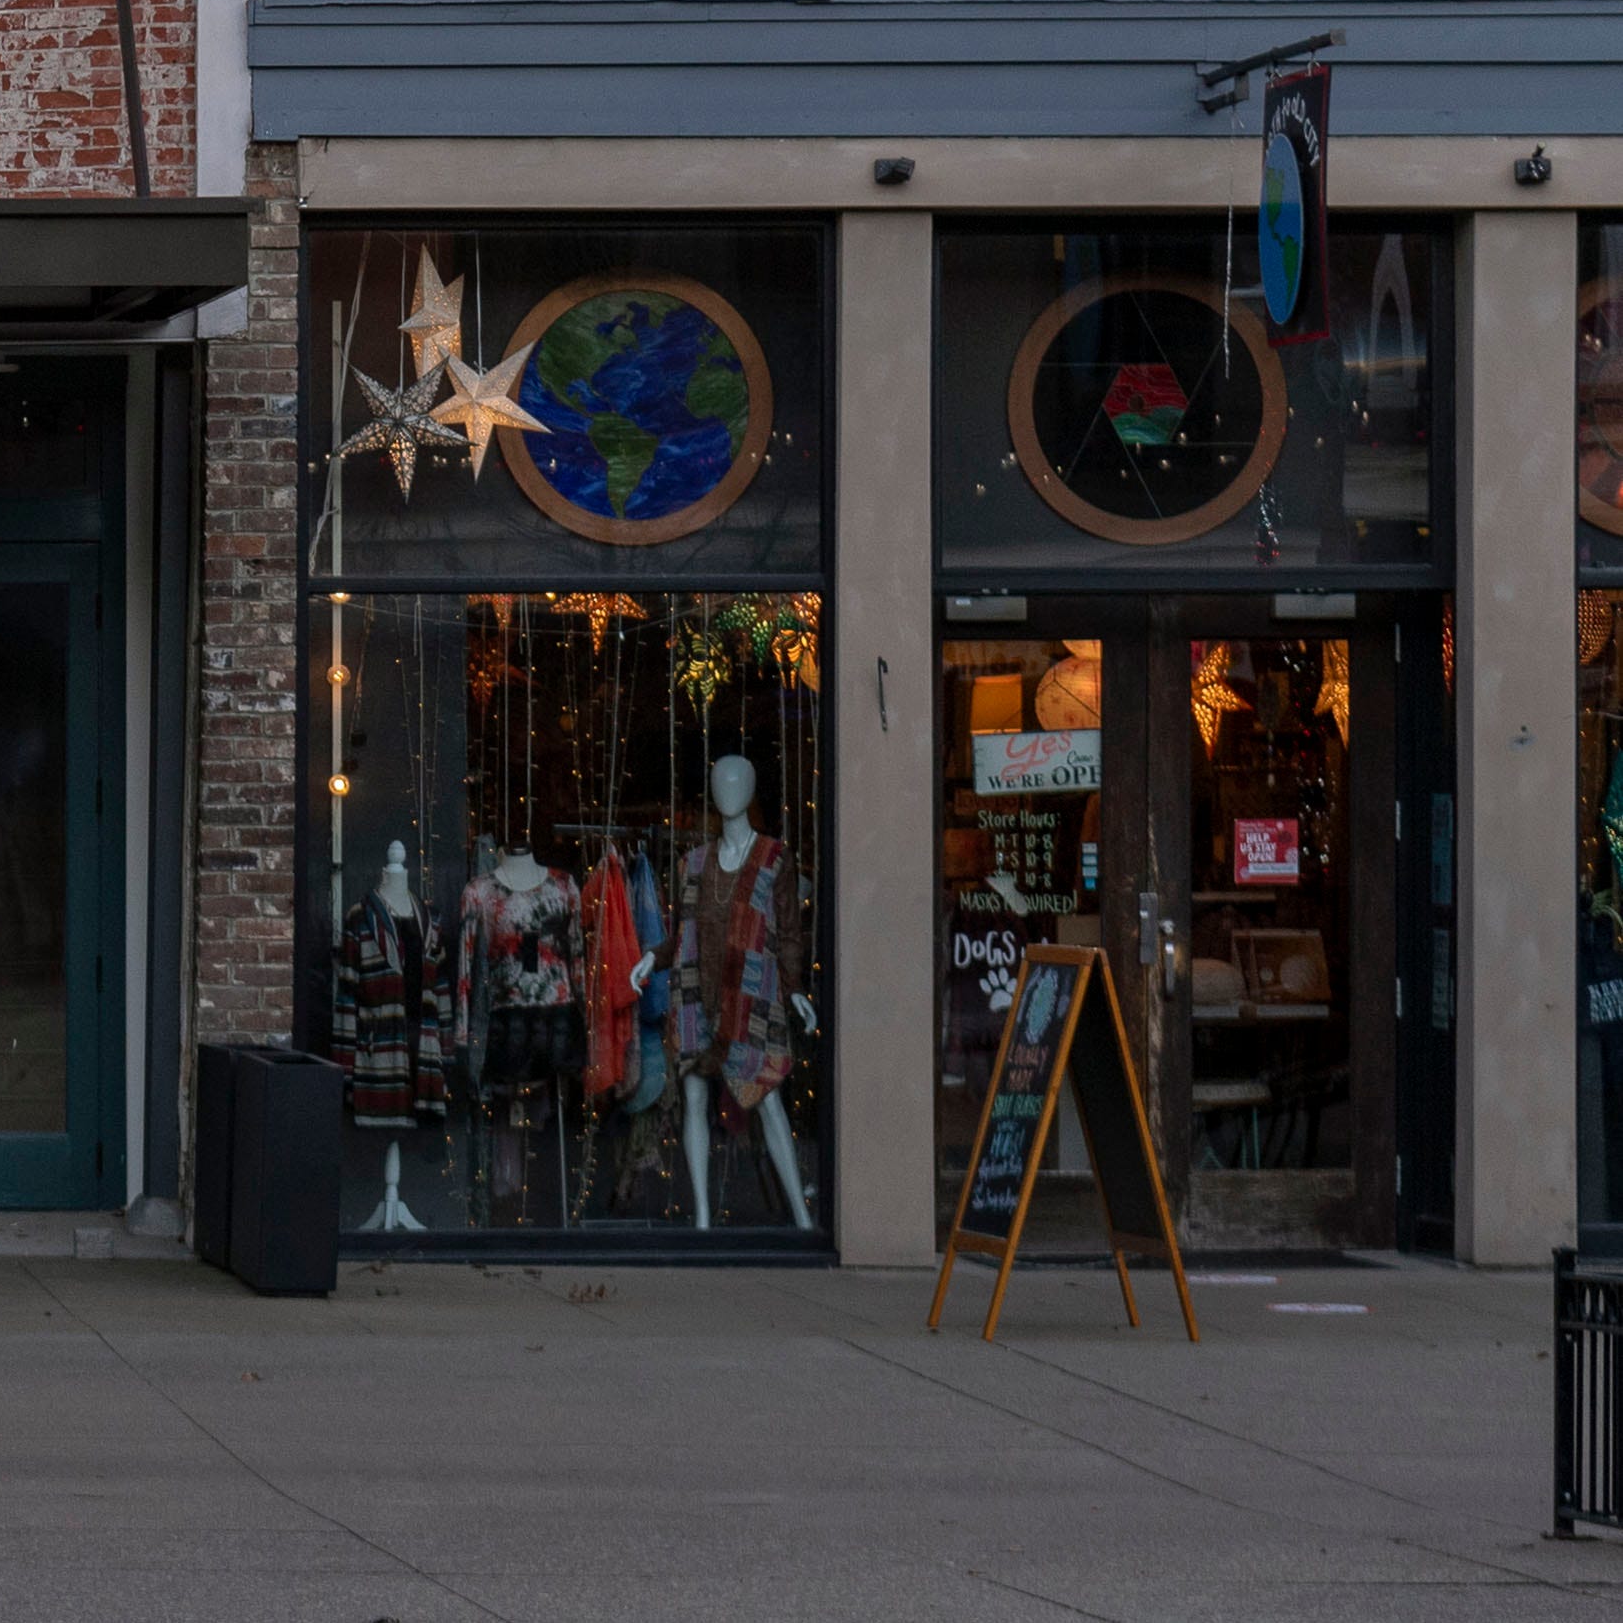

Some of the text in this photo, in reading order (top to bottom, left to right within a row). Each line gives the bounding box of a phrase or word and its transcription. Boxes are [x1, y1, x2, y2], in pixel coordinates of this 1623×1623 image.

[1051, 764, 1101, 786] OPE
[977, 809, 1016, 830] Store
[1246, 832, 1271, 843] HELP
